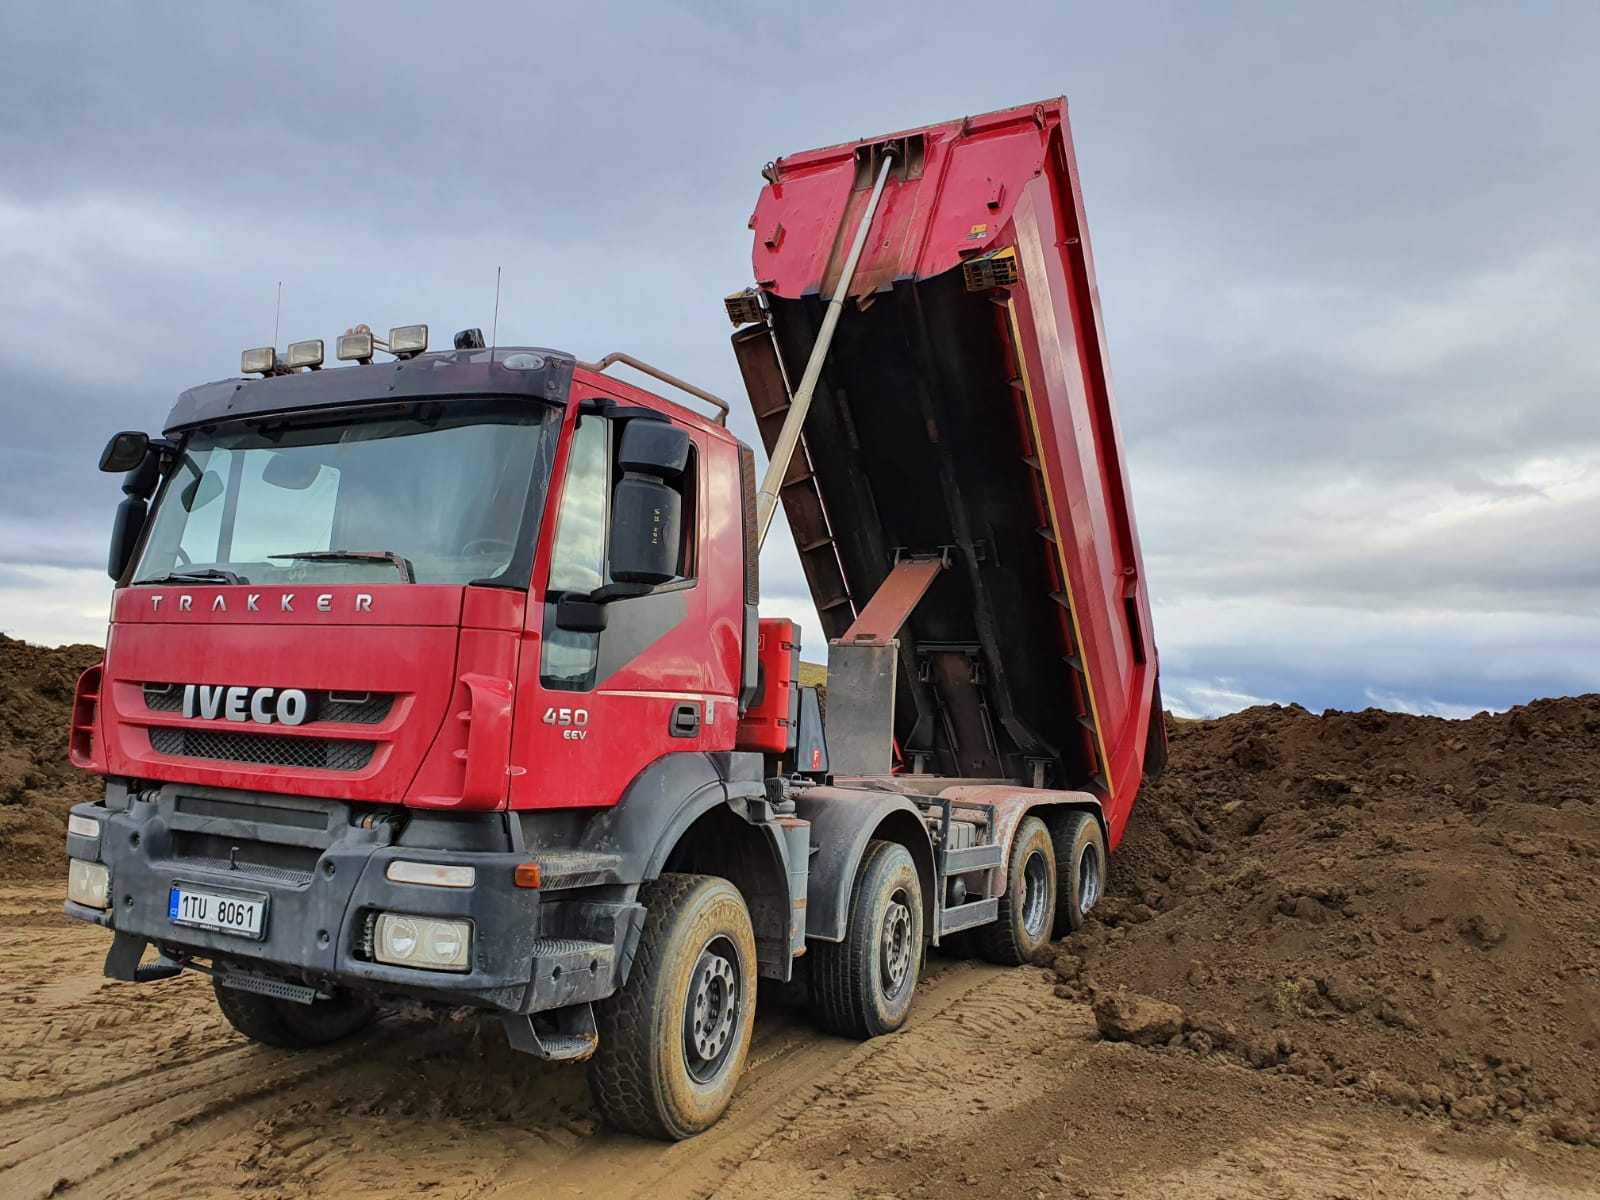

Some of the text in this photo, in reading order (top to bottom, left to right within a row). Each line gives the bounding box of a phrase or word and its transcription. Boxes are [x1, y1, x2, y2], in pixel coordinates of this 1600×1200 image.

[151, 594, 373, 612] TRAKKER
[182, 684, 307, 726] IVECO
[543, 707, 588, 726] 450
[563, 730, 587, 740] EEV
[183, 896, 207, 919] 1TU
[218, 901, 254, 928] 8061
